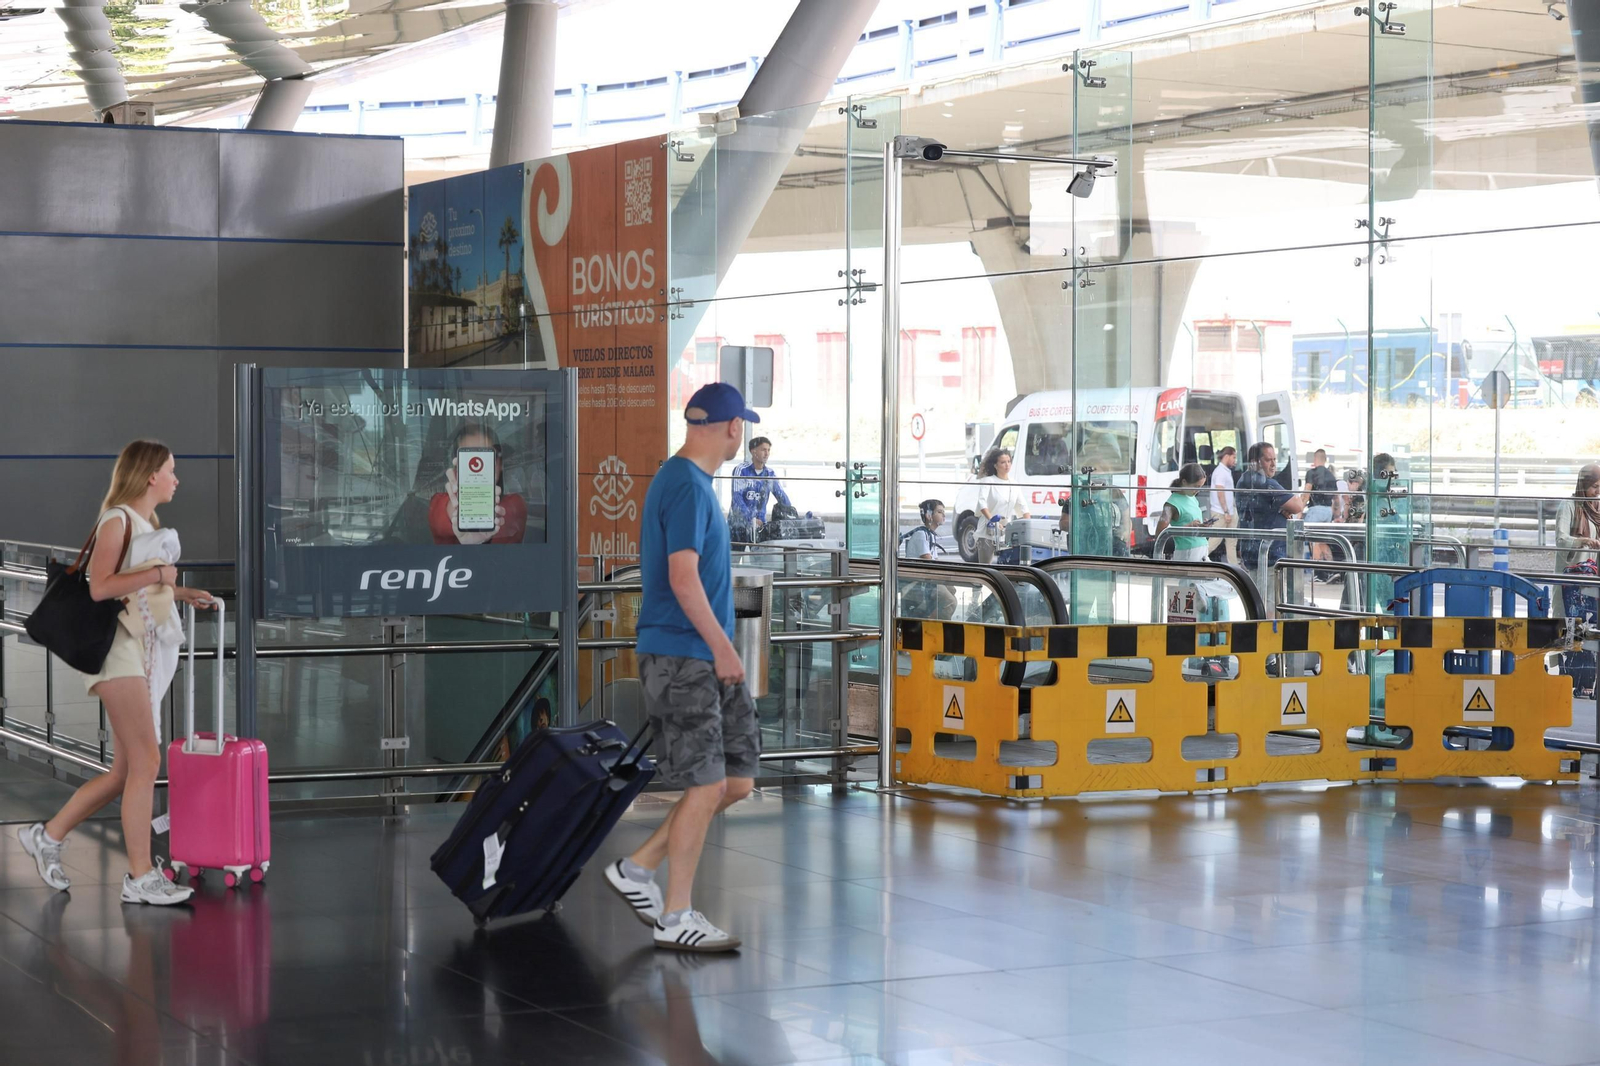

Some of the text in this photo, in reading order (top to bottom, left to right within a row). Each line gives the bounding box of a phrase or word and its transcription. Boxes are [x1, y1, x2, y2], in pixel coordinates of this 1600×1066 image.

[572, 248, 655, 295] BONOS
[572, 296, 655, 328] TURÍSTICOS
[573, 345, 653, 362] VUELOS DIRECTOS
[577, 362, 655, 379] ERRY DESDE MÁLAGA
[591, 384, 605, 394] hasta
[618, 384, 625, 393] de
[626, 384, 655, 393] descuento
[330, 400, 399, 417] estamos
[406, 402, 425, 417] en
[427, 398, 521, 421] WhatsApp
[627, 397, 655, 407] descuento
[1086, 404, 1140, 414] COURTESY BUS
[1028, 407, 1041, 417] BUS
[1041, 407, 1049, 417] DE
[590, 531, 637, 562] Melilla
[360, 555, 473, 602] renfe
